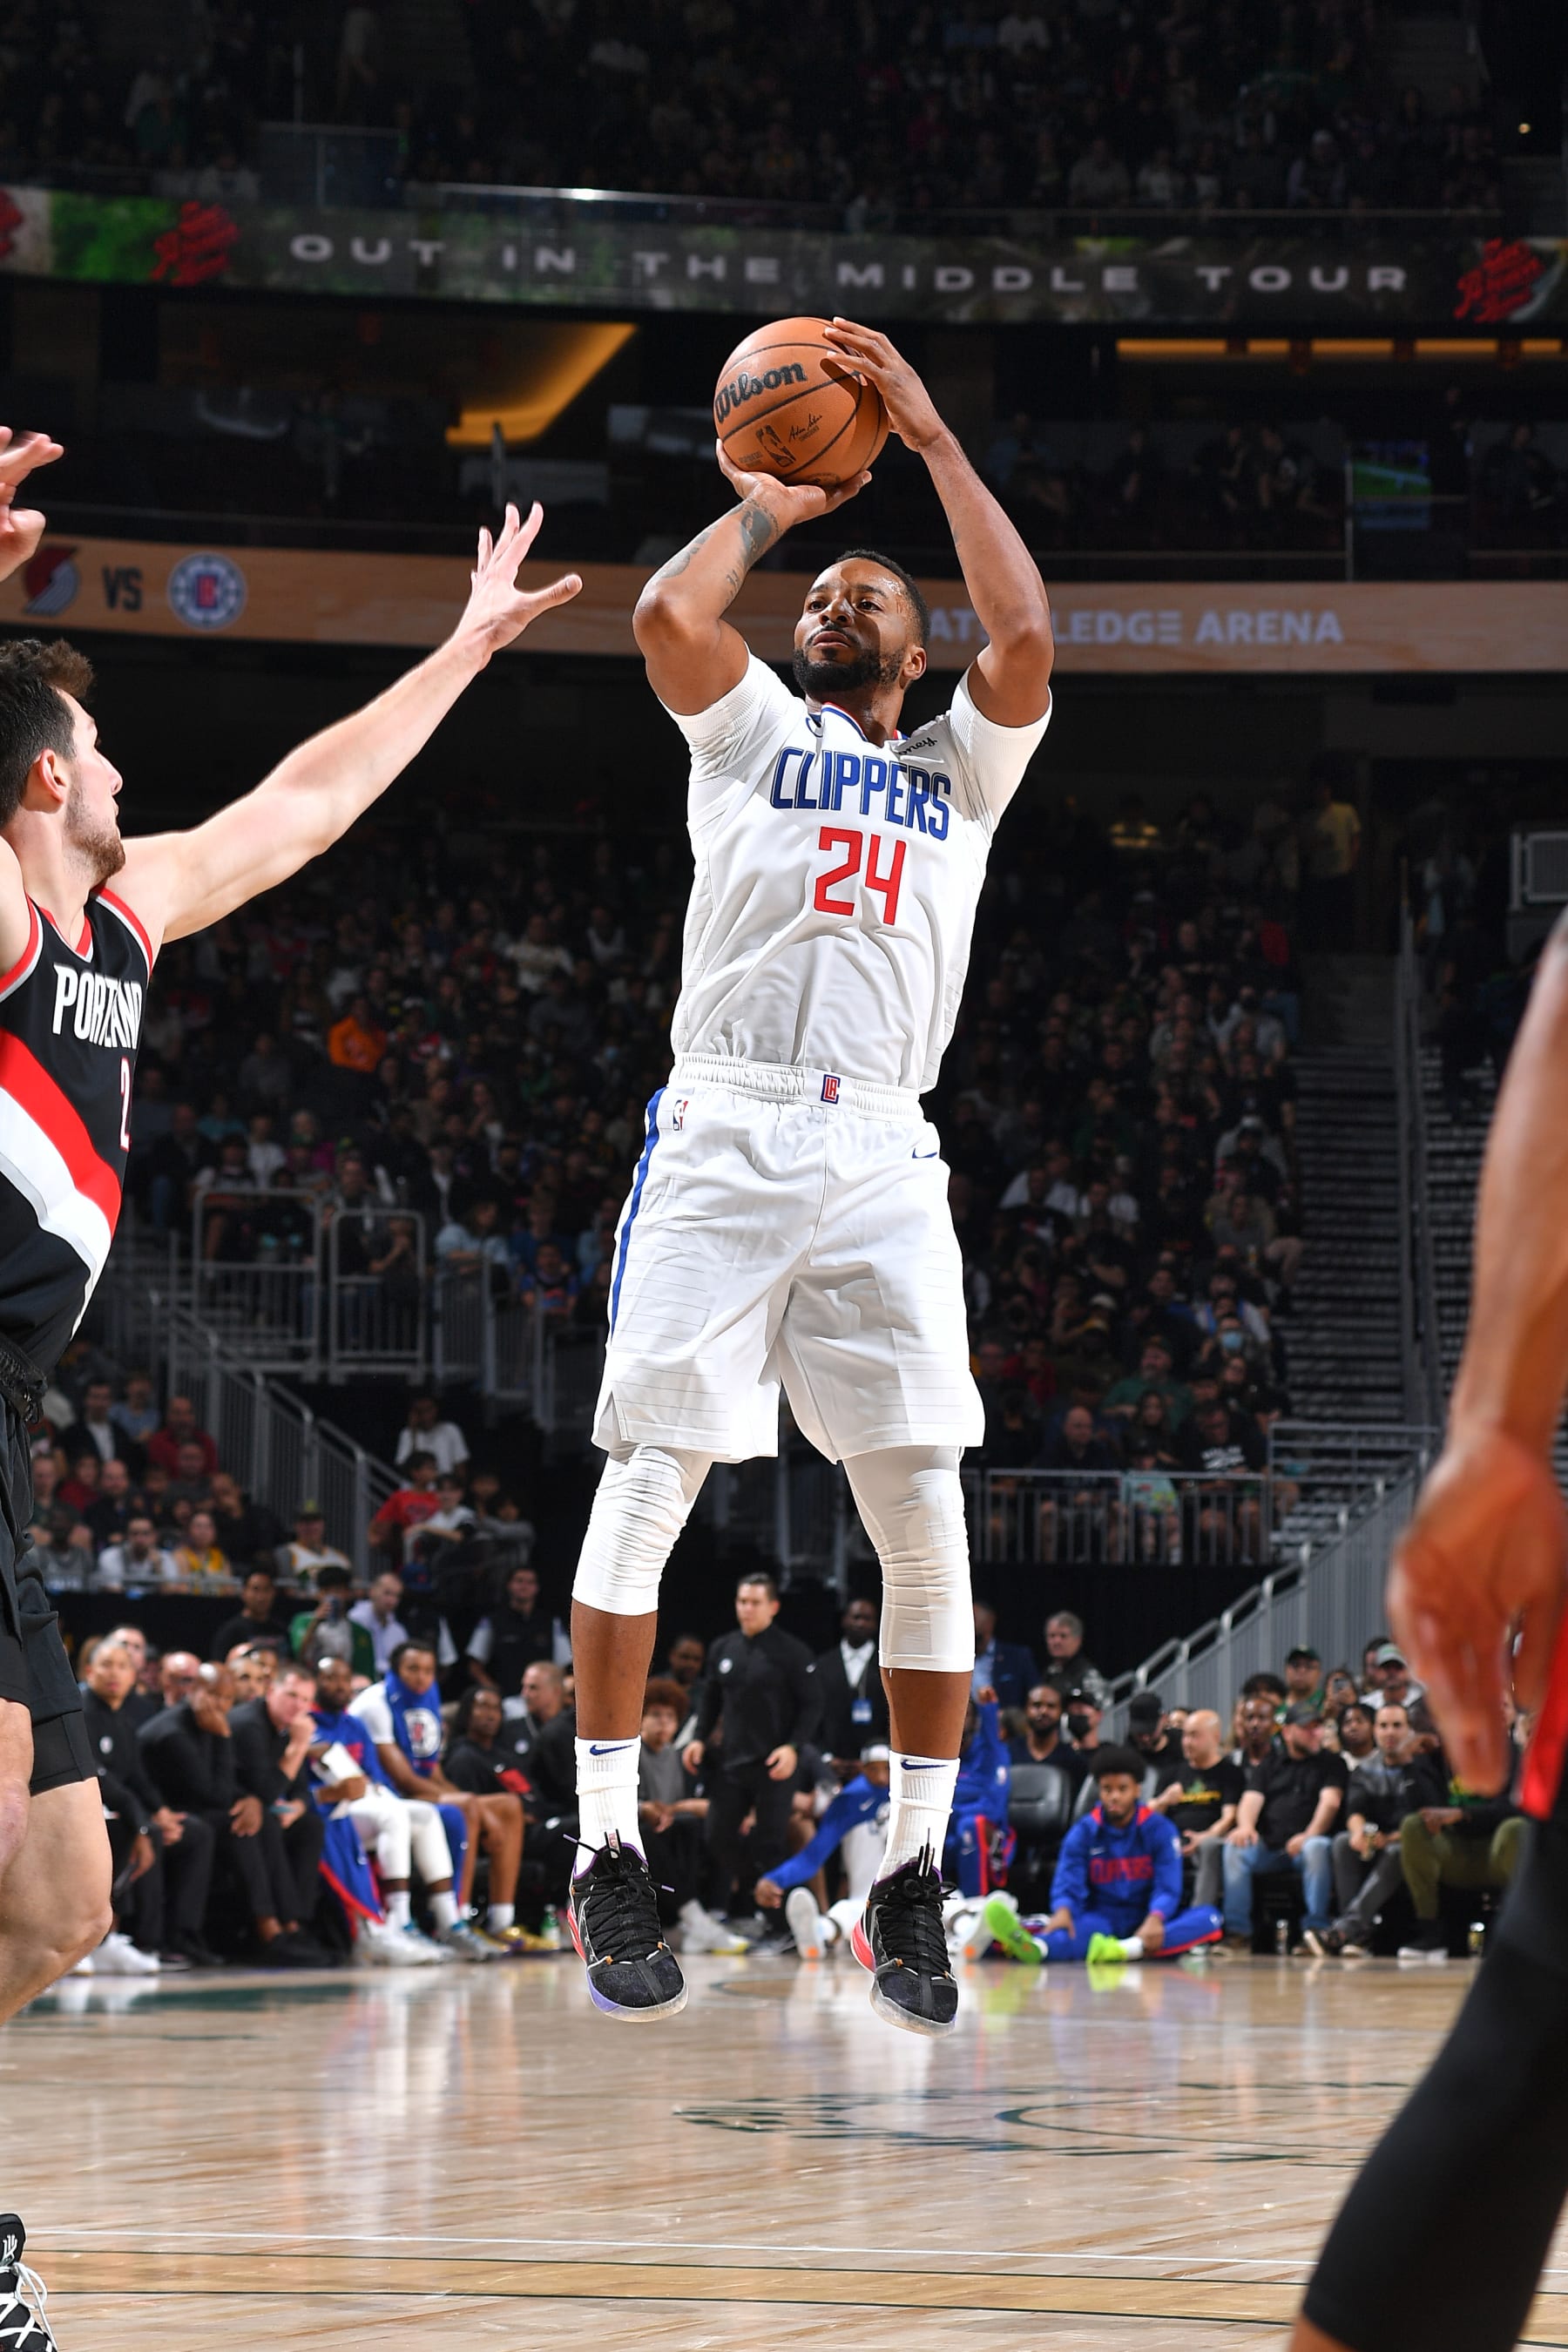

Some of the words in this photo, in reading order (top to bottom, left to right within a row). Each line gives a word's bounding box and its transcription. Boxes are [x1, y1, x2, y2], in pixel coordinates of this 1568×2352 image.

[289, 233, 446, 267] OUT
[502, 245, 576, 274] IN
[633, 250, 783, 282] THE
[836, 261, 1139, 293] MIDDLE
[1196, 265, 1409, 293] TOUR
[714, 362, 808, 424] Wilson
[102, 565, 143, 612] VS
[1051, 612, 1181, 645] LEDGE
[1194, 612, 1344, 645] ARENA
[898, 737, 938, 755] oney
[770, 746, 951, 841] CLIPPERS
[814, 826, 907, 926] 24
[52, 962, 143, 1050] PORTLAND
